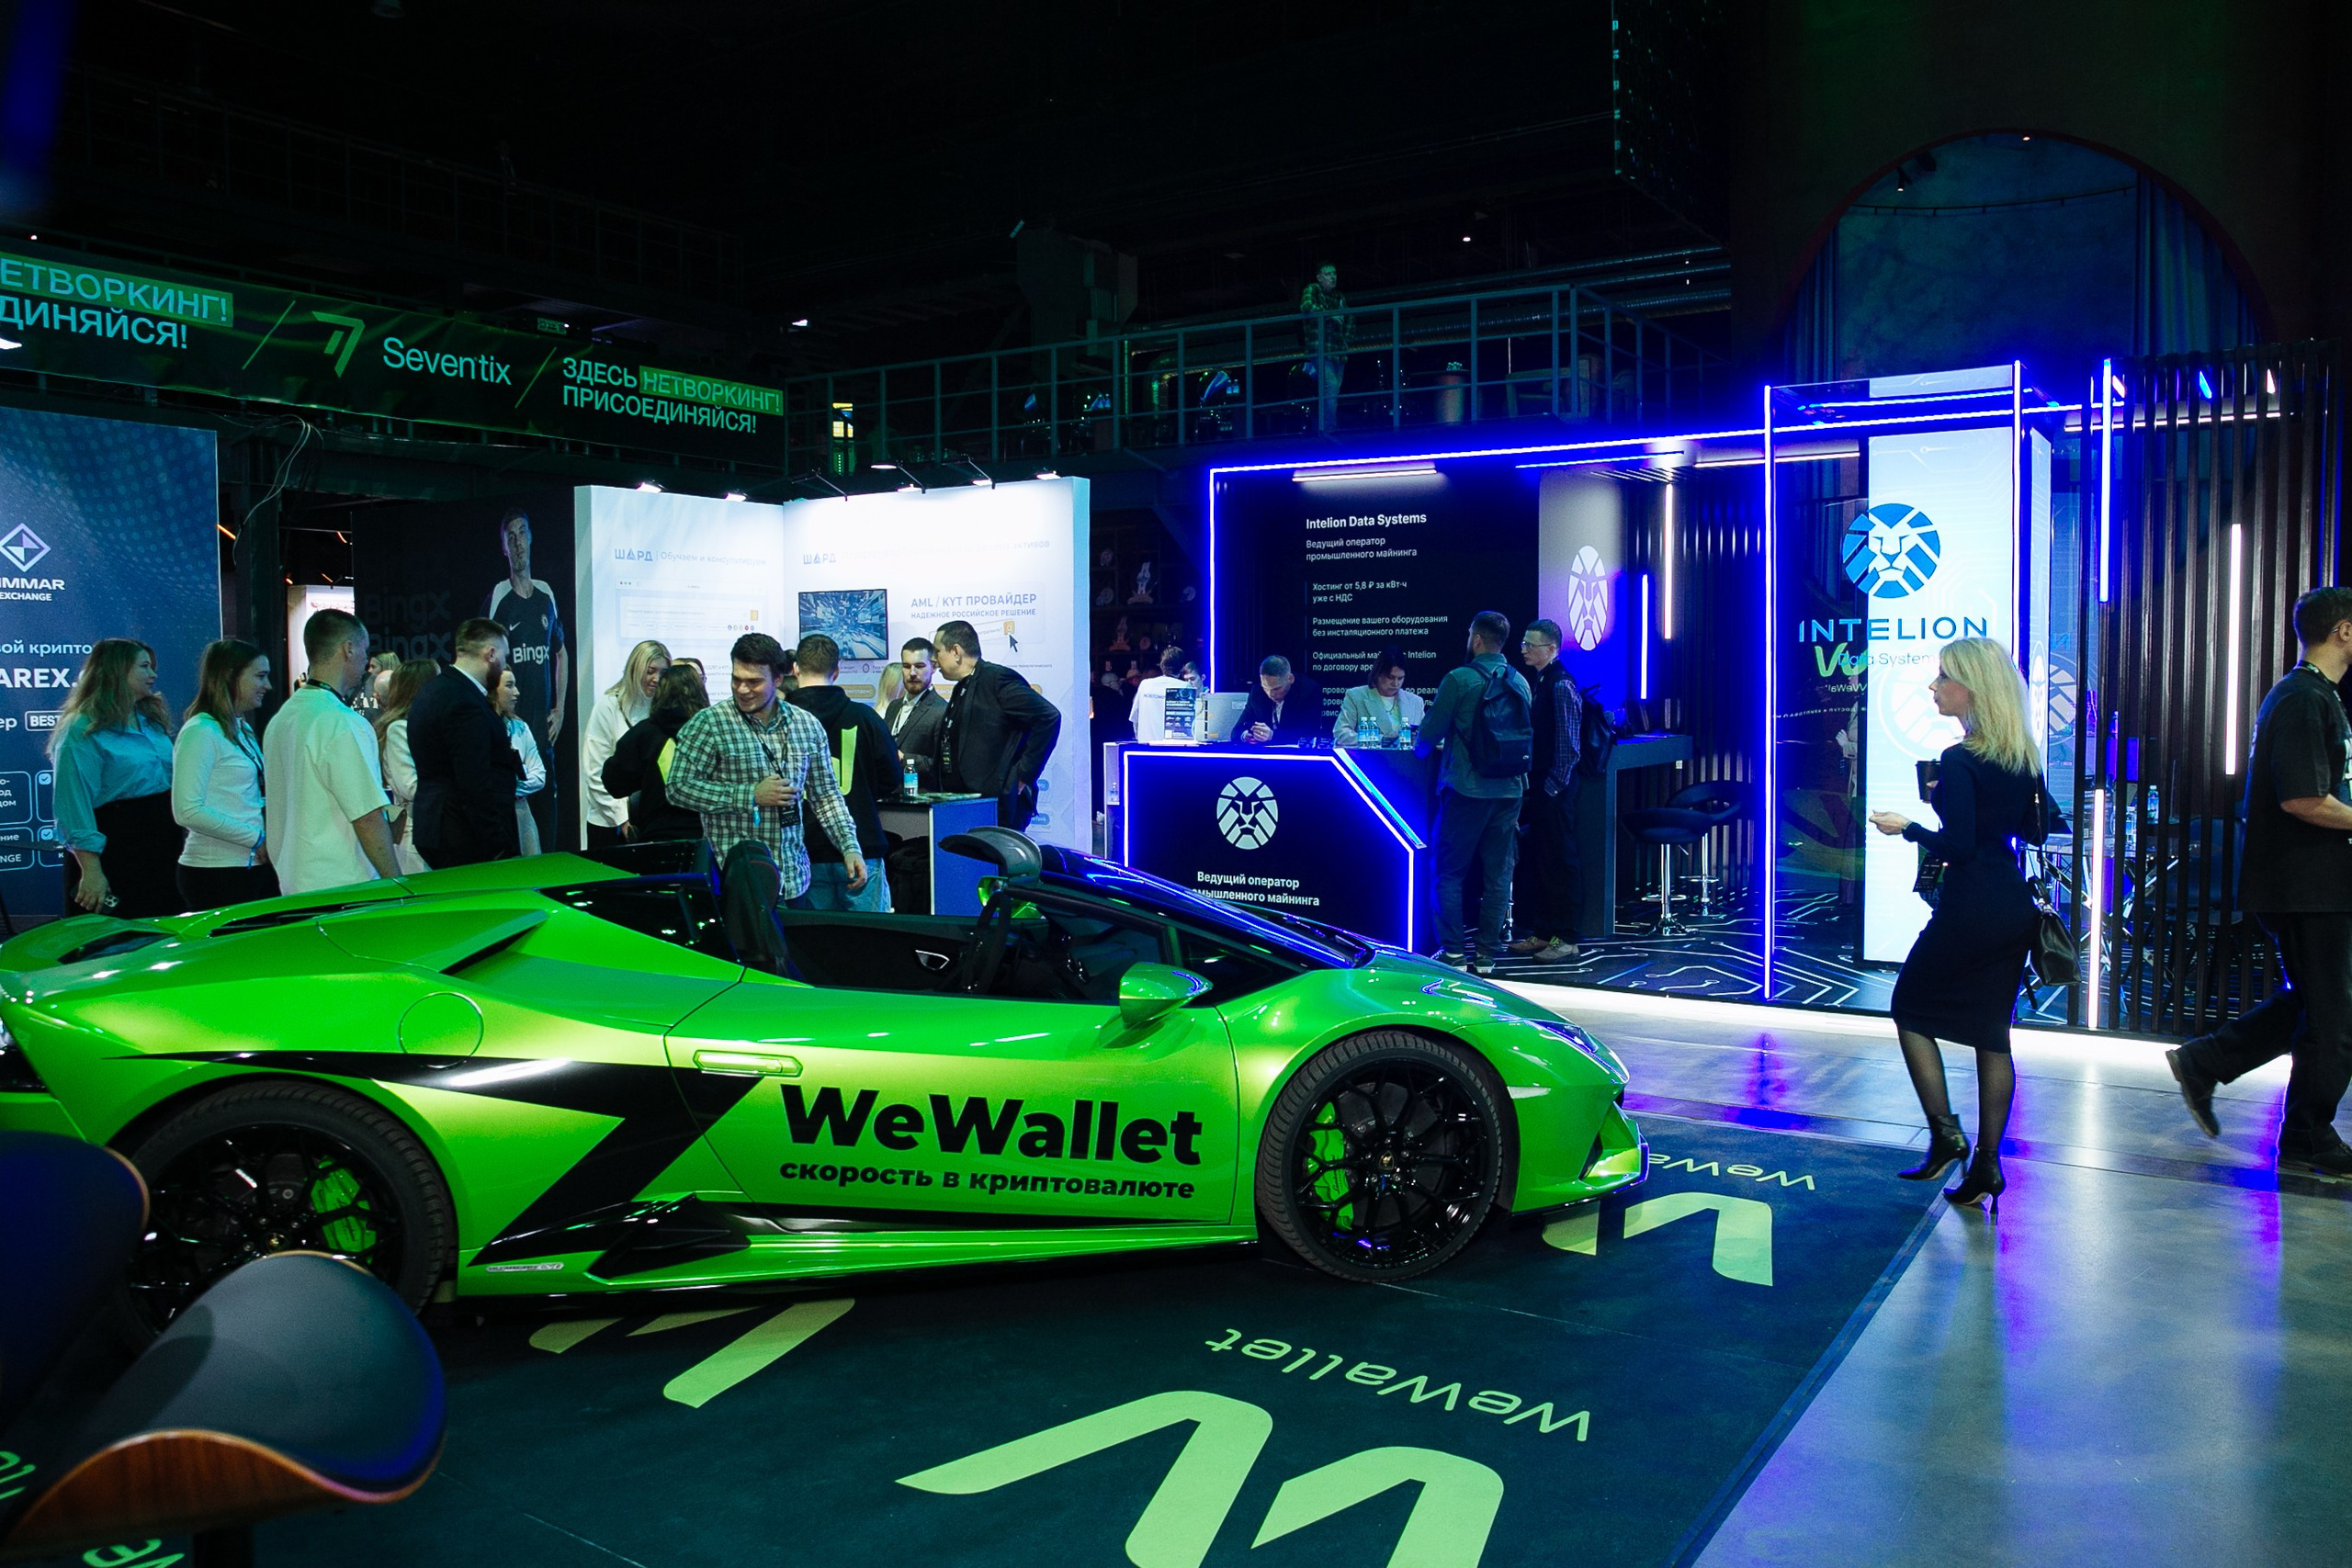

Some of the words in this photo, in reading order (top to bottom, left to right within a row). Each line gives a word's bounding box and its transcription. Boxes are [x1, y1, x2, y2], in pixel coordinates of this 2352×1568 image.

[0, 258, 227, 321] ЕТВОРКИНГ!
[0, 295, 187, 349] ДИНЯЙСЯ!
[382, 336, 512, 386] Seventix
[562, 357, 637, 389] ЗДЕСЬ
[643, 370, 780, 412] НЕТВОРКИНГ!
[562, 385, 757, 434] ПРИСОЕДИНЯЙСЯ!
[1306, 517, 1346, 529] Intelion
[1349, 516, 1374, 527] Data
[1377, 513, 1427, 527] Systems
[1306, 538, 1344, 548] Ведущий
[1346, 537, 1385, 547] оператор
[661, 551, 697, 561] Обучаем
[1306, 550, 1374, 562] промышленного
[1376, 548, 1418, 558] майнинга
[1313, 582, 1342, 591] Хостинг
[1355, 581, 1367, 590] 5,8
[0, 592, 52, 601] EXCHANGE
[911, 598, 933, 607] AML
[966, 592, 1036, 605] ПРОВАЙДЕР
[1313, 595, 1328, 604] уже
[1336, 594, 1353, 603] НДС
[952, 609, 1000, 618] РОССИЙСКОЕ
[1313, 617, 1360, 626] Размещение
[1392, 615, 1448, 625] оборудования
[1313, 628, 1326, 637] без
[1327, 628, 1394, 637] инсталяционного
[1799, 616, 1987, 642] INTELION
[0, 639, 24, 653] ой
[29, 644, 93, 657] крипто
[1313, 651, 1365, 660] Официальный
[1408, 650, 1436, 659] Intelion
[1323, 663, 1358, 671] договору
[1197, 872, 1246, 886] Ведущий
[1248, 876, 1299, 890] оператор
[1268, 894, 1319, 906] майнинга
[779, 1083, 1204, 1166] WeWallet
[779, 1161, 932, 1188] скорость
[942, 1170, 960, 1189] в
[968, 1171, 1195, 1199] криптовалюте
